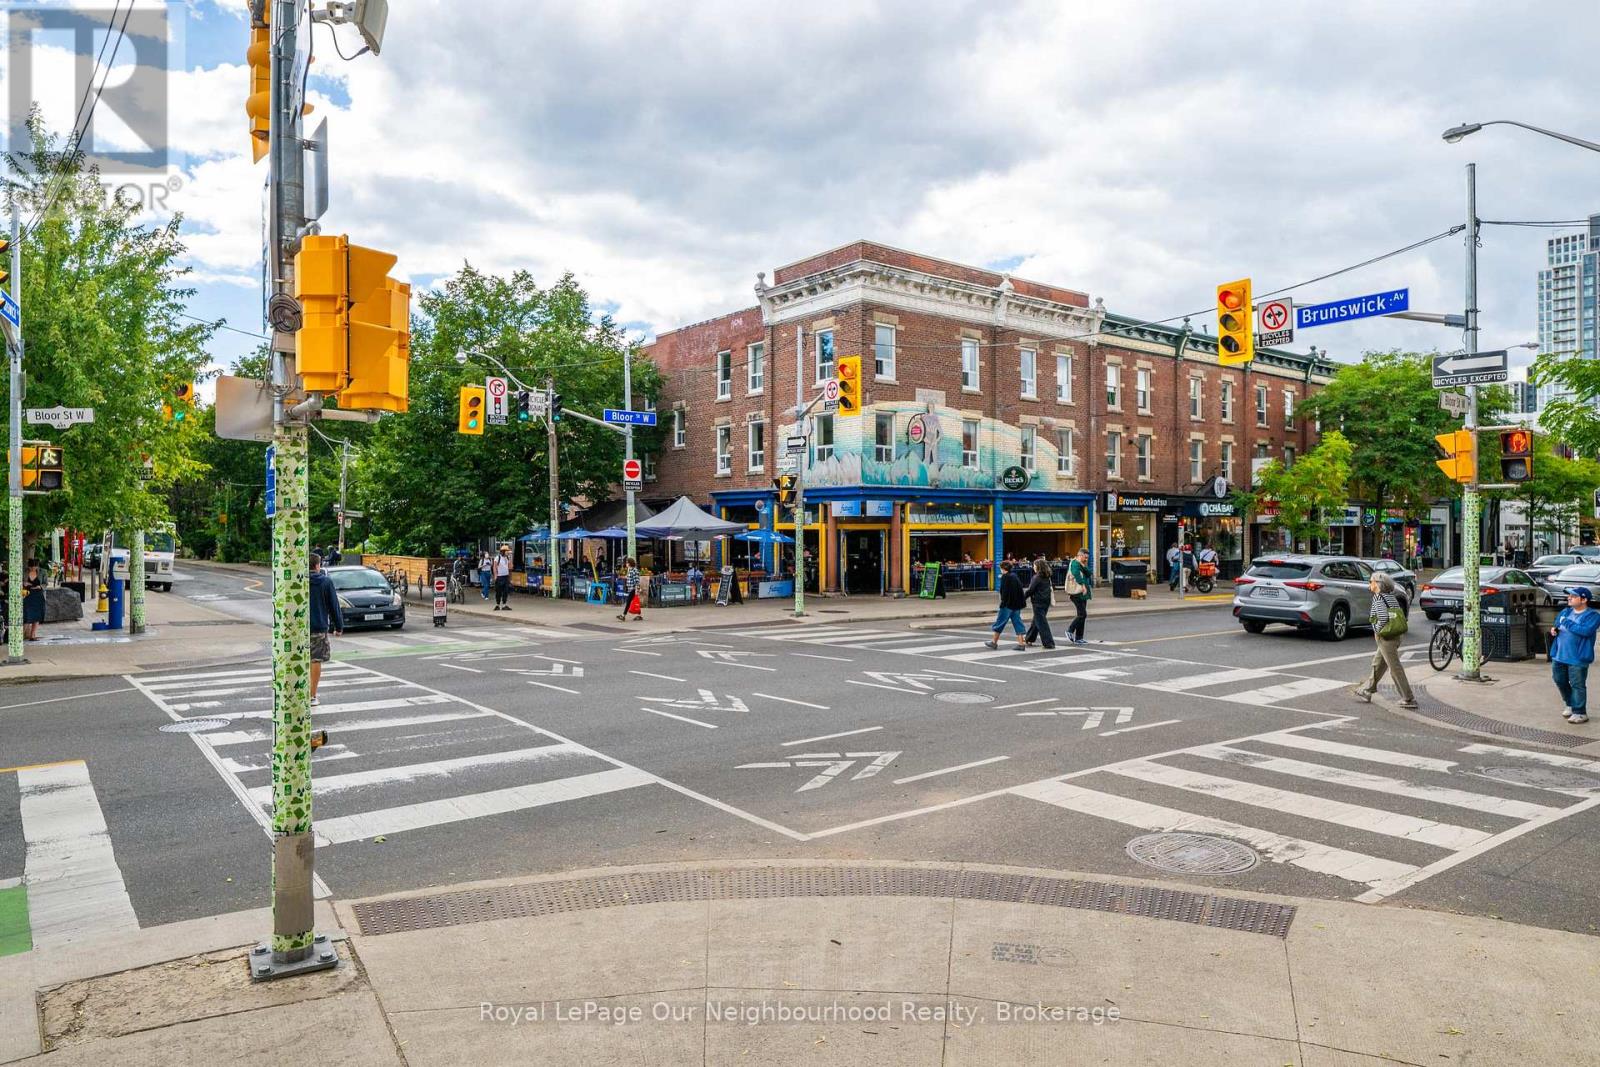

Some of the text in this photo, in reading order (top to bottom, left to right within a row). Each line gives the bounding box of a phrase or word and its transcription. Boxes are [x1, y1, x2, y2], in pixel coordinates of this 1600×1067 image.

[1302, 292, 1404, 324] Brunswick Av
[1261, 331, 1290, 342] BICYCLES
[1261, 338, 1290, 348] EXCEPTED
[1433, 372, 1507, 387] BICYCLES EXCEPTED
[35, 410, 84, 421] Bloor St W
[611, 411, 634, 422] Bloor
[642, 414, 650, 423] W
[1118, 496, 1167, 507] Brown Donkatsu
